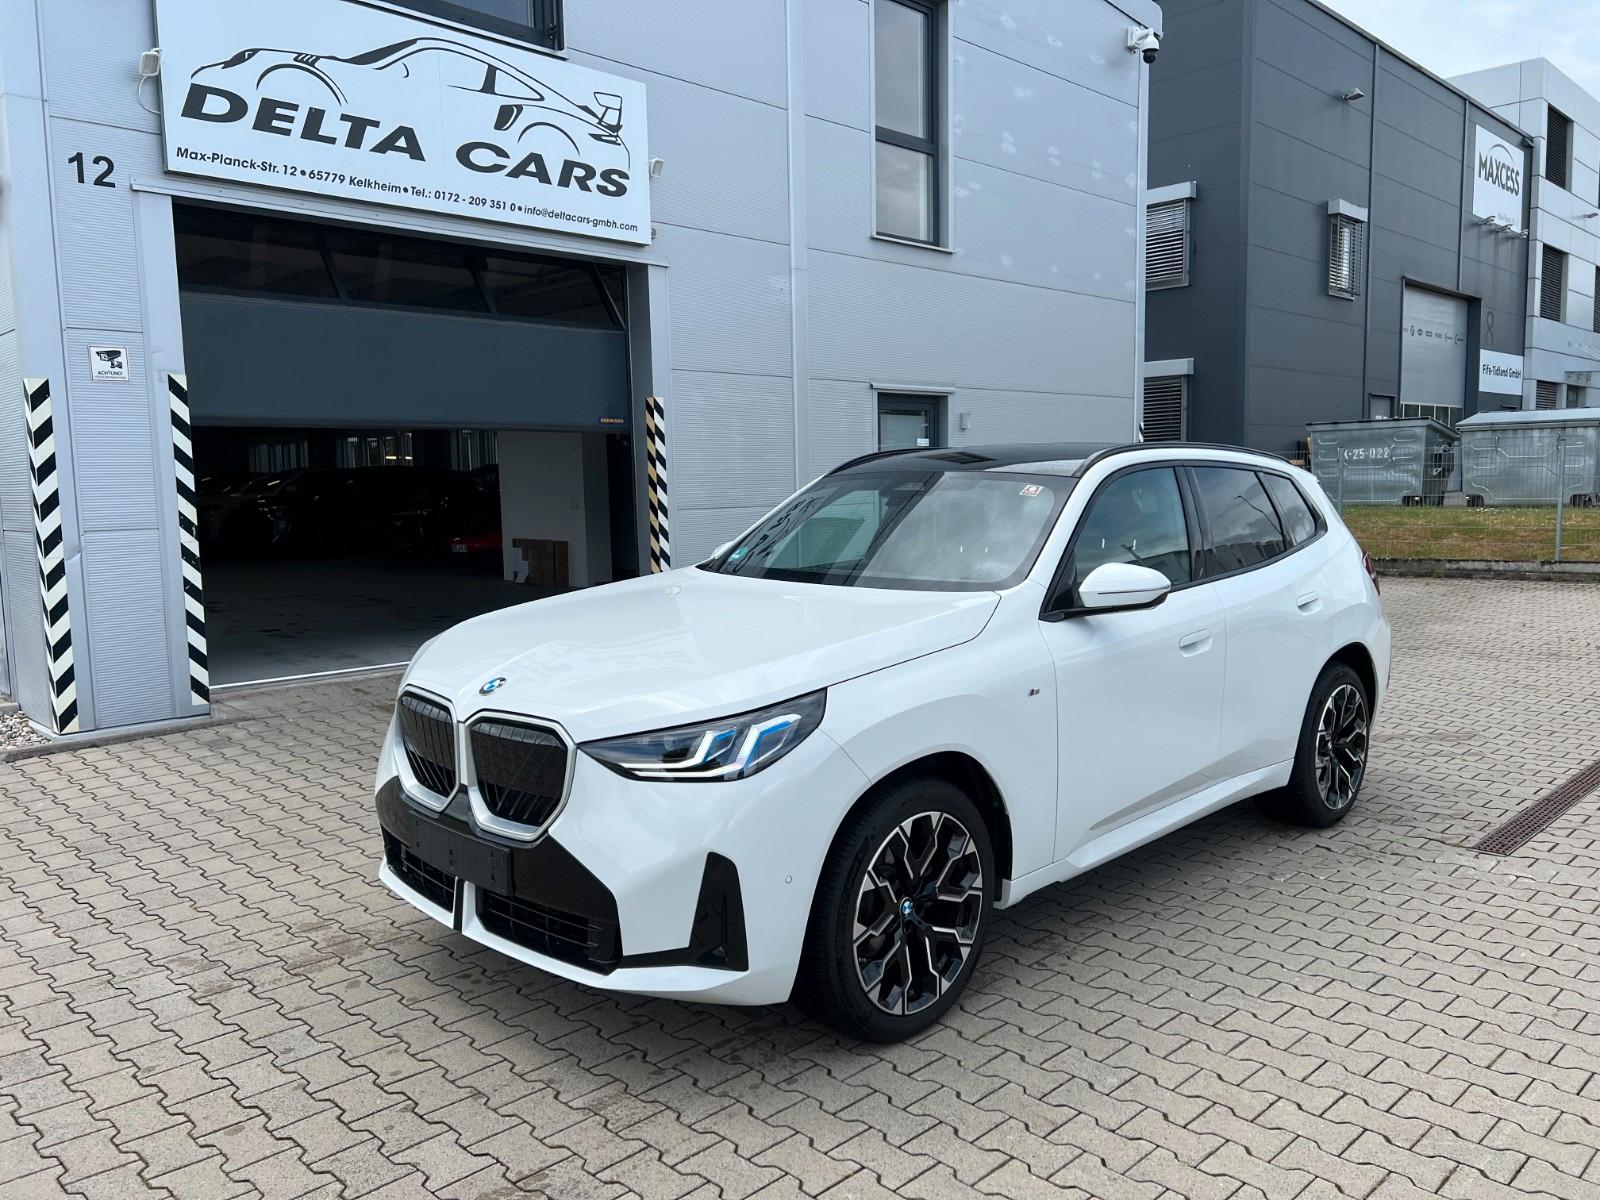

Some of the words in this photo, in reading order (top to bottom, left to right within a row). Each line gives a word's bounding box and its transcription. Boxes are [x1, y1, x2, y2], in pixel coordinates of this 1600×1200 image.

[180, 82, 426, 162] DELTA
[455, 141, 630, 198] CARS
[68, 151, 116, 188] 12
[176, 146, 280, 174] Max-Planck-Str.
[282, 164, 297, 177] 12
[308, 169, 345, 184] 65779
[349, 175, 401, 194] Kelkheim
[410, 186, 432, 199] Tel.:
[434, 190, 460, 203] 0172
[468, 195, 487, 208] 209
[489, 199, 506, 211] 351
[524, 204, 638, 233] info@deltacars-gmbh.com
[1478, 150, 1520, 197] MAXCESS
[1509, 367, 1522, 379] GmbH
